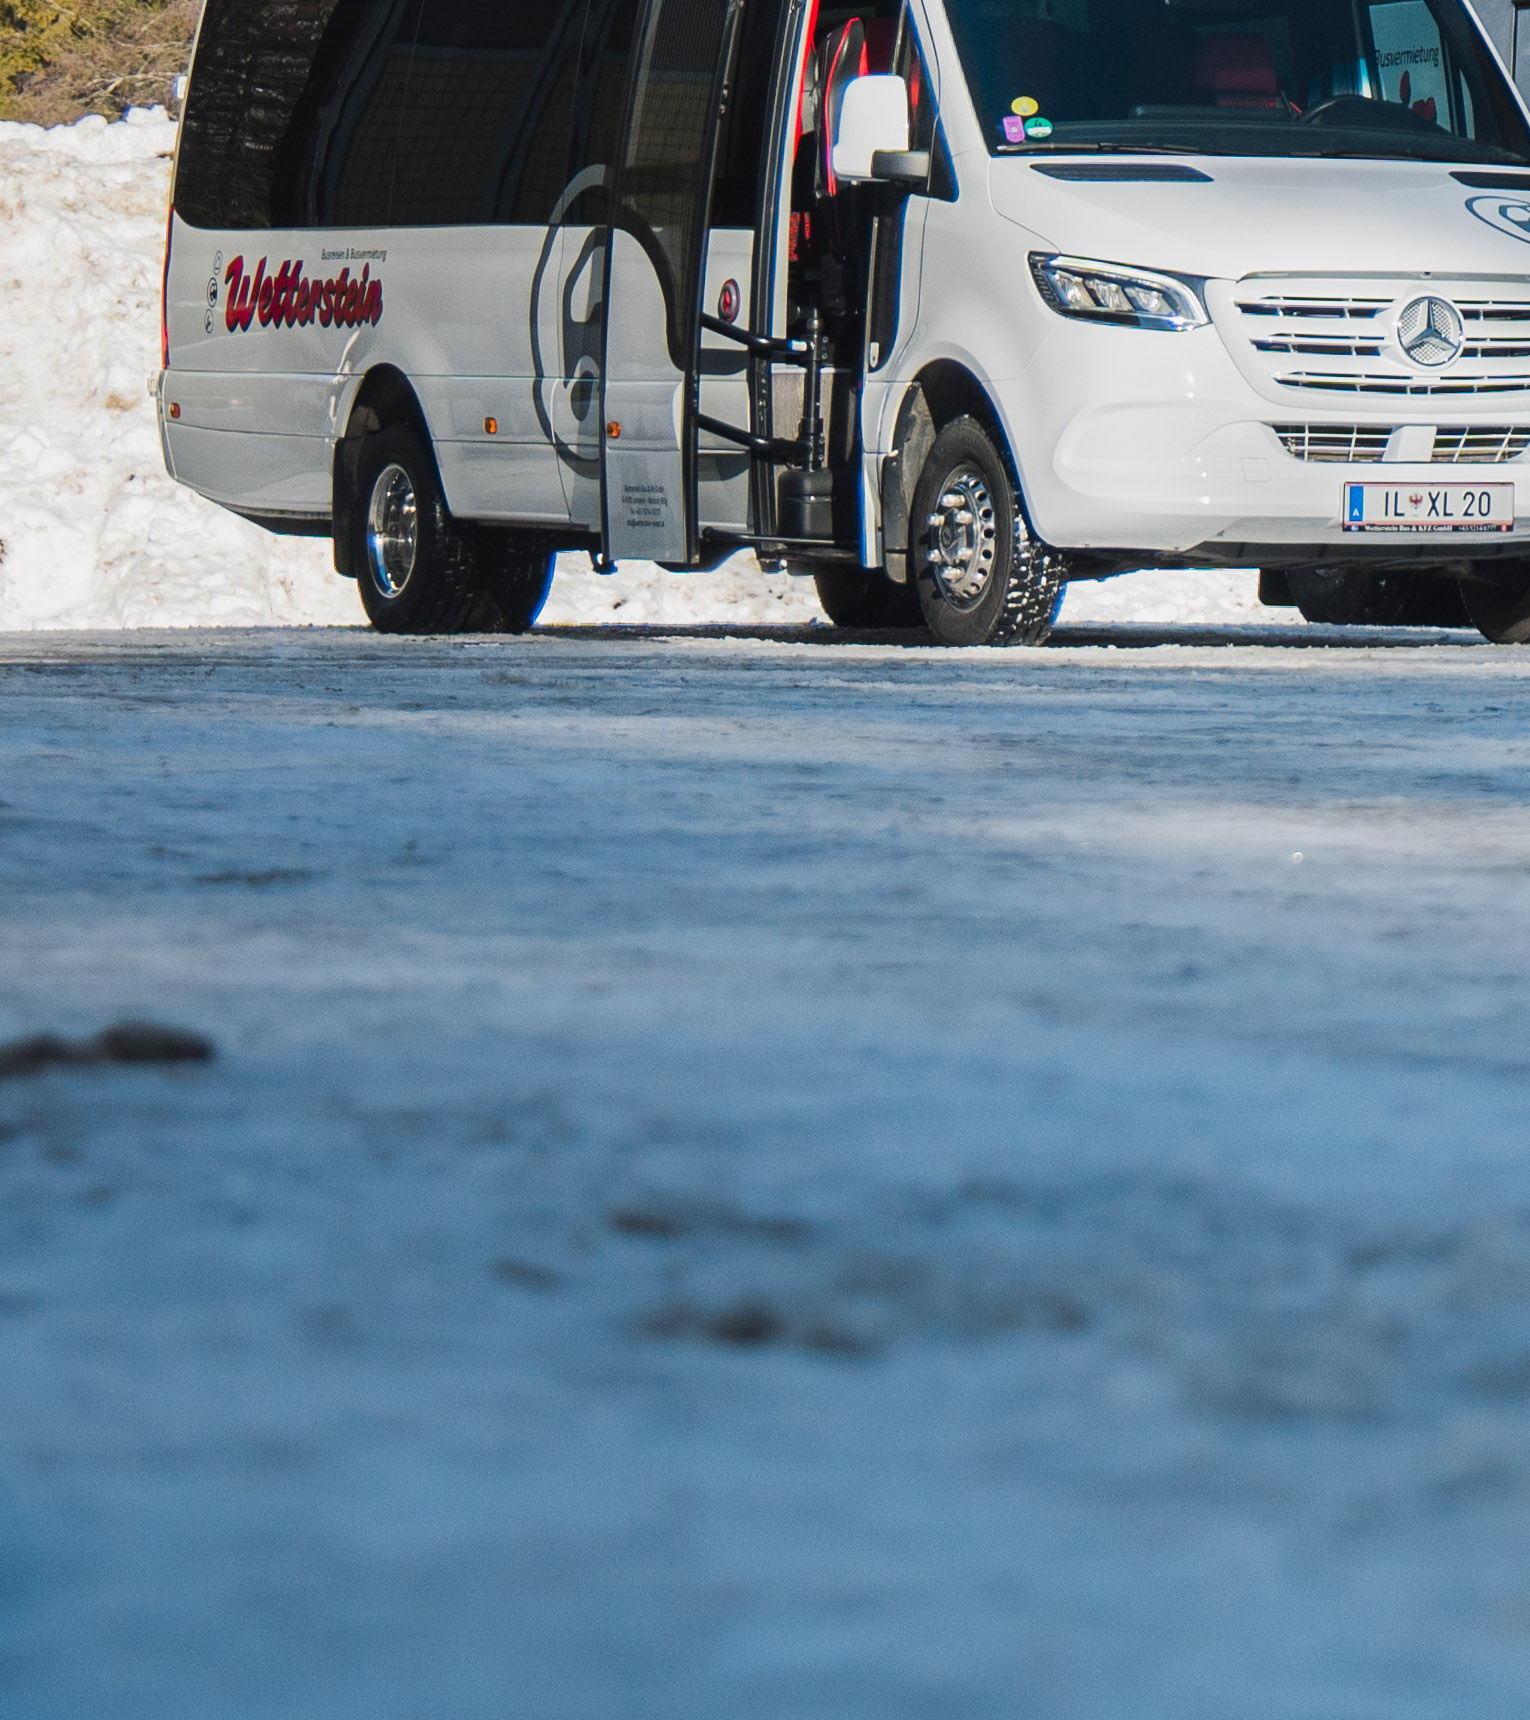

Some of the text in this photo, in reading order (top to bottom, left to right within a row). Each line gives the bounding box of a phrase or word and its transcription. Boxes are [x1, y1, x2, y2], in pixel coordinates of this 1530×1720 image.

[224, 254, 384, 333] Wetterstein
[1352, 490, 1492, 517] A IL XL 20
